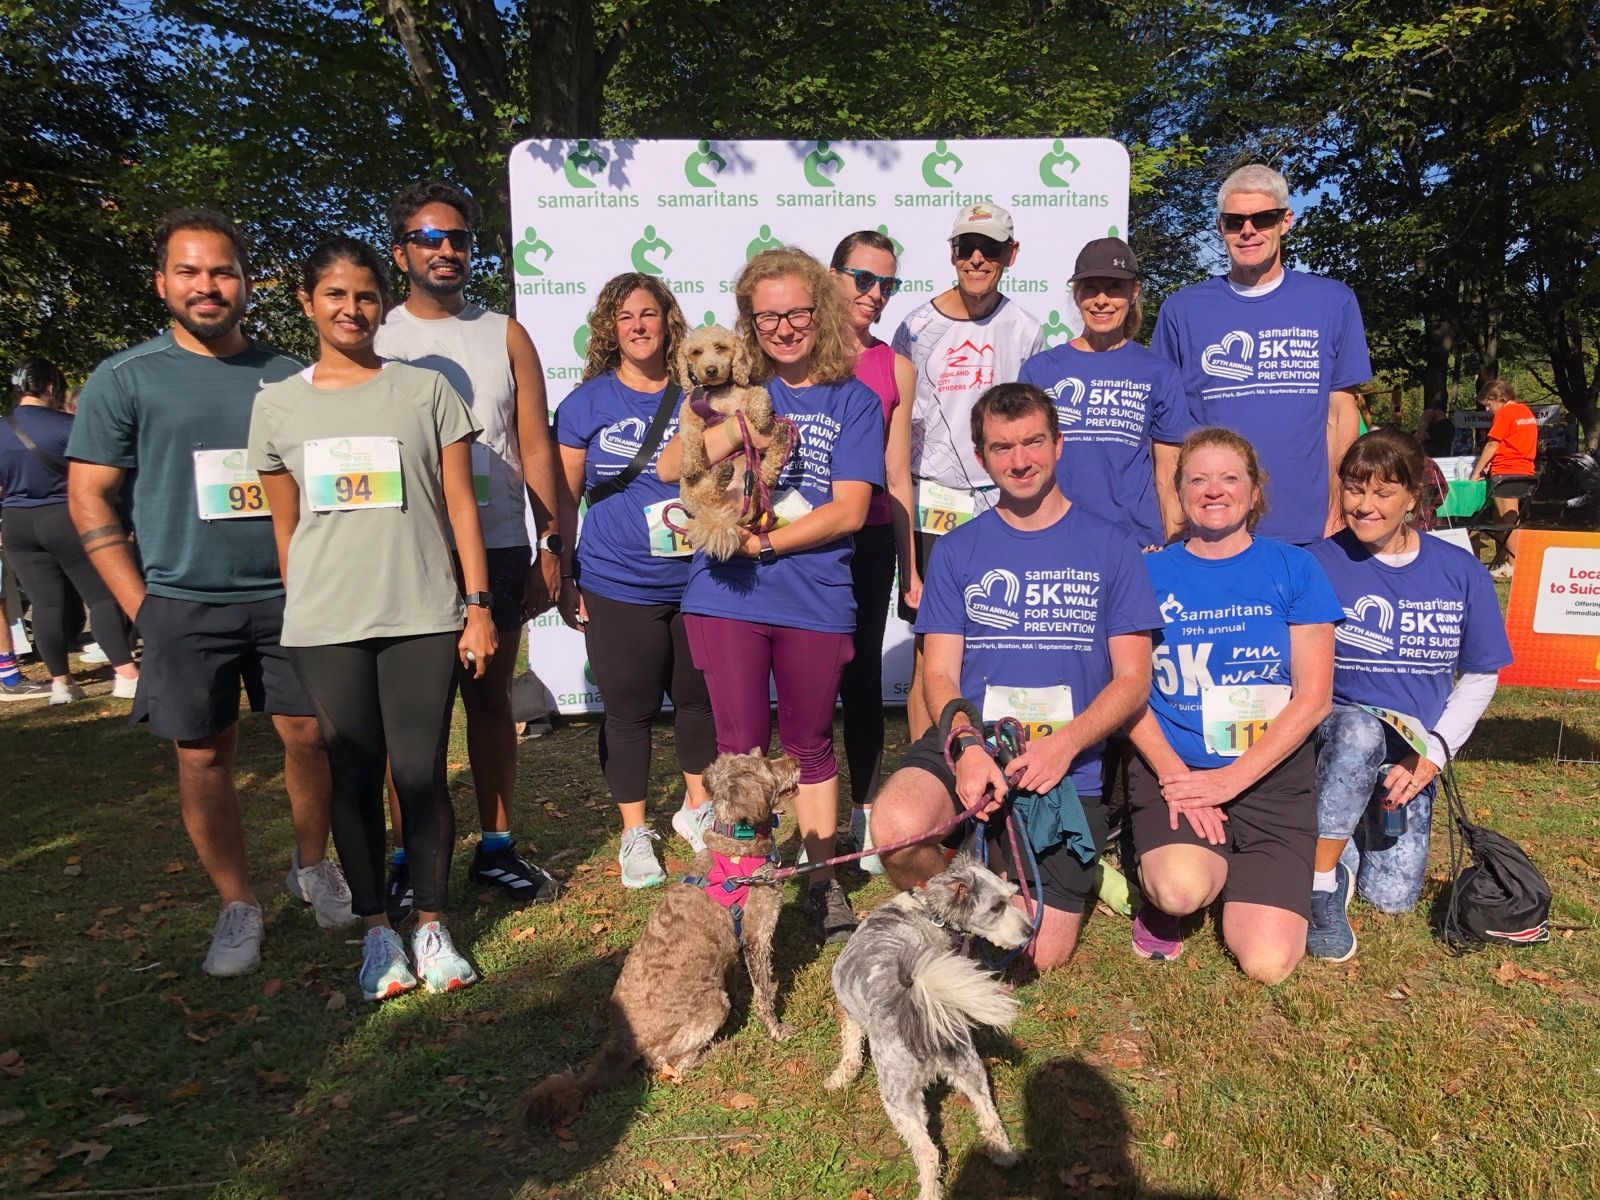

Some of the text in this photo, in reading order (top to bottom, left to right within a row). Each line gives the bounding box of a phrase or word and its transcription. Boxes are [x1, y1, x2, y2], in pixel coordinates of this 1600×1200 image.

[537, 191, 640, 208] samaritans
[657, 190, 758, 207] samaritans
[776, 190, 876, 207] samaritans
[1011, 190, 1109, 207] samaritans
[1258, 326, 1320, 339] samaritans
[1259, 340, 1289, 358] 5K
[1290, 350, 1319, 358] WALK
[1258, 360, 1320, 369] FOR SUICIDE
[1258, 371, 1320, 380] PREVENTION
[1090, 379, 1152, 392] samaritans
[1089, 389, 1119, 405] 5K
[1121, 399, 1146, 412] WALK
[1086, 407, 1145, 423] FOR SUICIDE
[1085, 418, 1143, 433] PREVENTION
[335, 475, 372, 502] 94
[229, 485, 263, 511] 93
[921, 508, 957, 531] 178
[1025, 568, 1100, 582] samaritans
[1025, 583, 1100, 606] 5K RUN/
[1550, 582, 1565, 594] to
[1064, 596, 1098, 608] WALK
[1398, 598, 1464, 611] samaritans
[973, 603, 1019, 619] 27TH ANNUAL
[1024, 608, 1097, 621] FOR SUICIDE
[1180, 604, 1273, 622] samaritans
[1024, 622, 1095, 634] PREVENTION
[1182, 622, 1246, 636] 19th annual
[1400, 612, 1438, 633] 5K
[1344, 624, 1394, 645] 27TH ANNUAL
[1400, 635, 1425, 646] FOR
[1152, 643, 1280, 696] 5K run
[1222, 662, 1281, 685] walk
